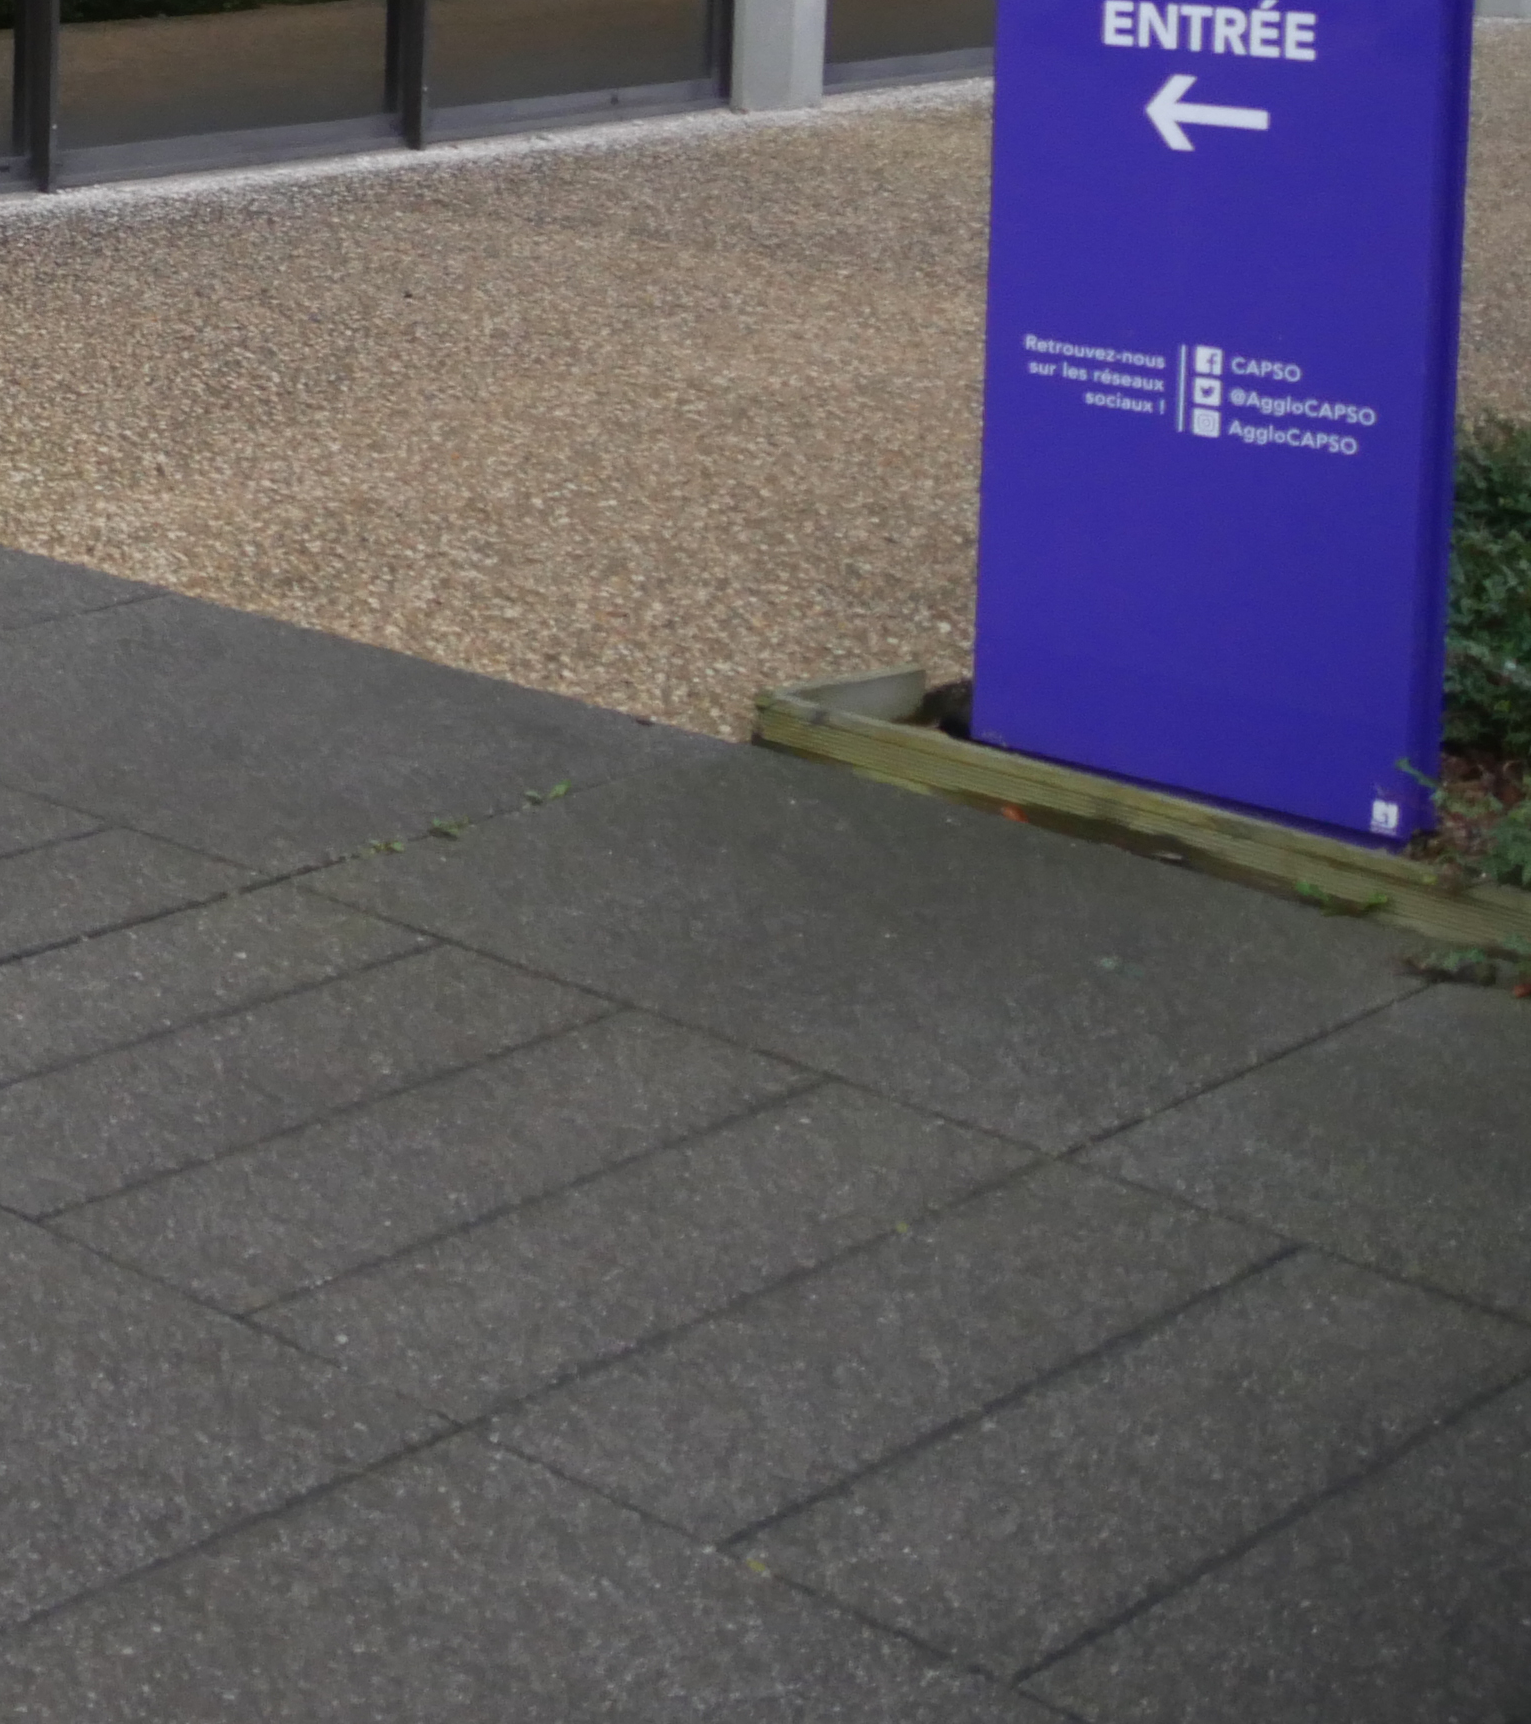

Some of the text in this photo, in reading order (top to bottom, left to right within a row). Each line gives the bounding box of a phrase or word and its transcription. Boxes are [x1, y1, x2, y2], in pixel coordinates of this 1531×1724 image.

[1024, 334, 1166, 369] Retrouvez-nous
[1029, 361, 1165, 392] sur les réseaux
[1231, 357, 1302, 383] CAPSO
[1084, 389, 1166, 415] sociaux !
[1229, 387, 1378, 427] @AggloCAPSO
[1228, 419, 1359, 456] AggloCAPSO
